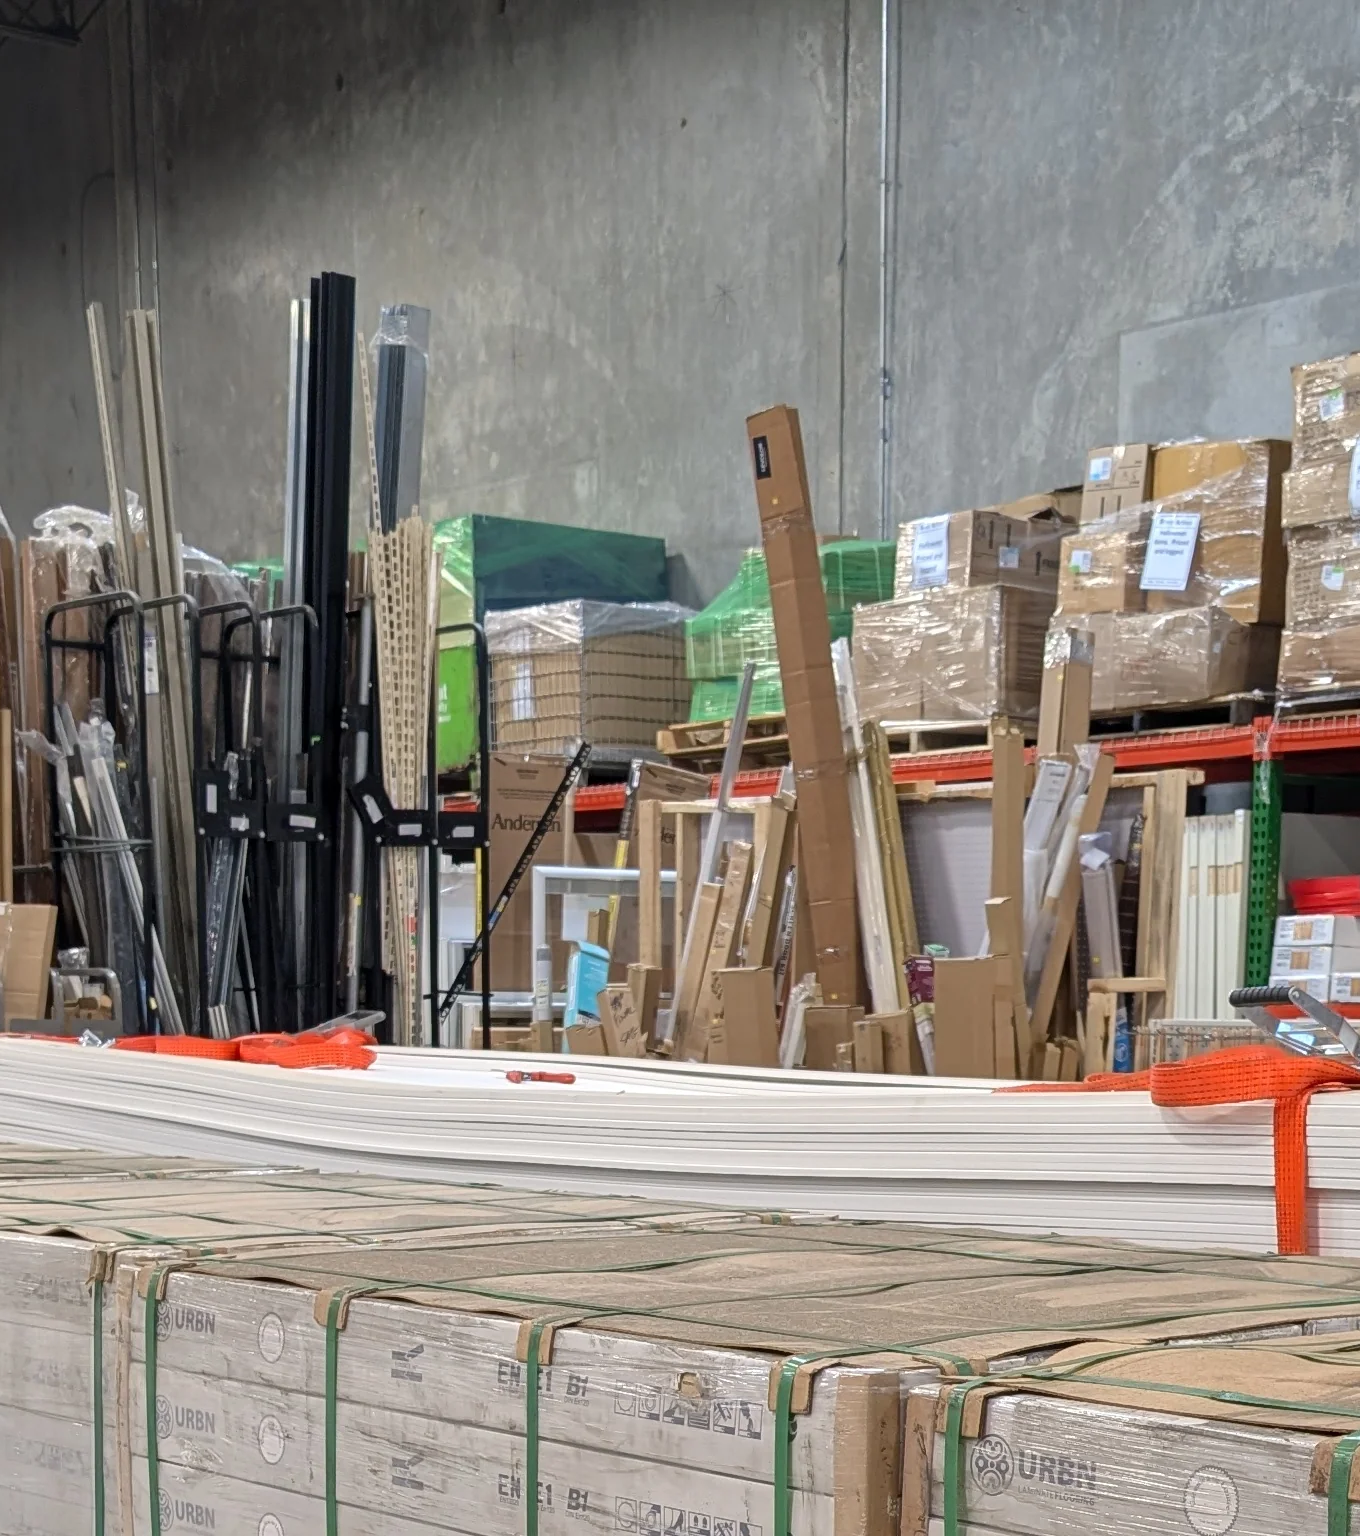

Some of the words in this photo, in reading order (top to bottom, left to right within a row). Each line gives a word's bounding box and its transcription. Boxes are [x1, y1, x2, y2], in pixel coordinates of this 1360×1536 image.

[175, 1308, 215, 1334] URBN
[175, 1406, 215, 1434] URBN
[567, 1488, 589, 1511] B1
[175, 1499, 215, 1529] URBN
